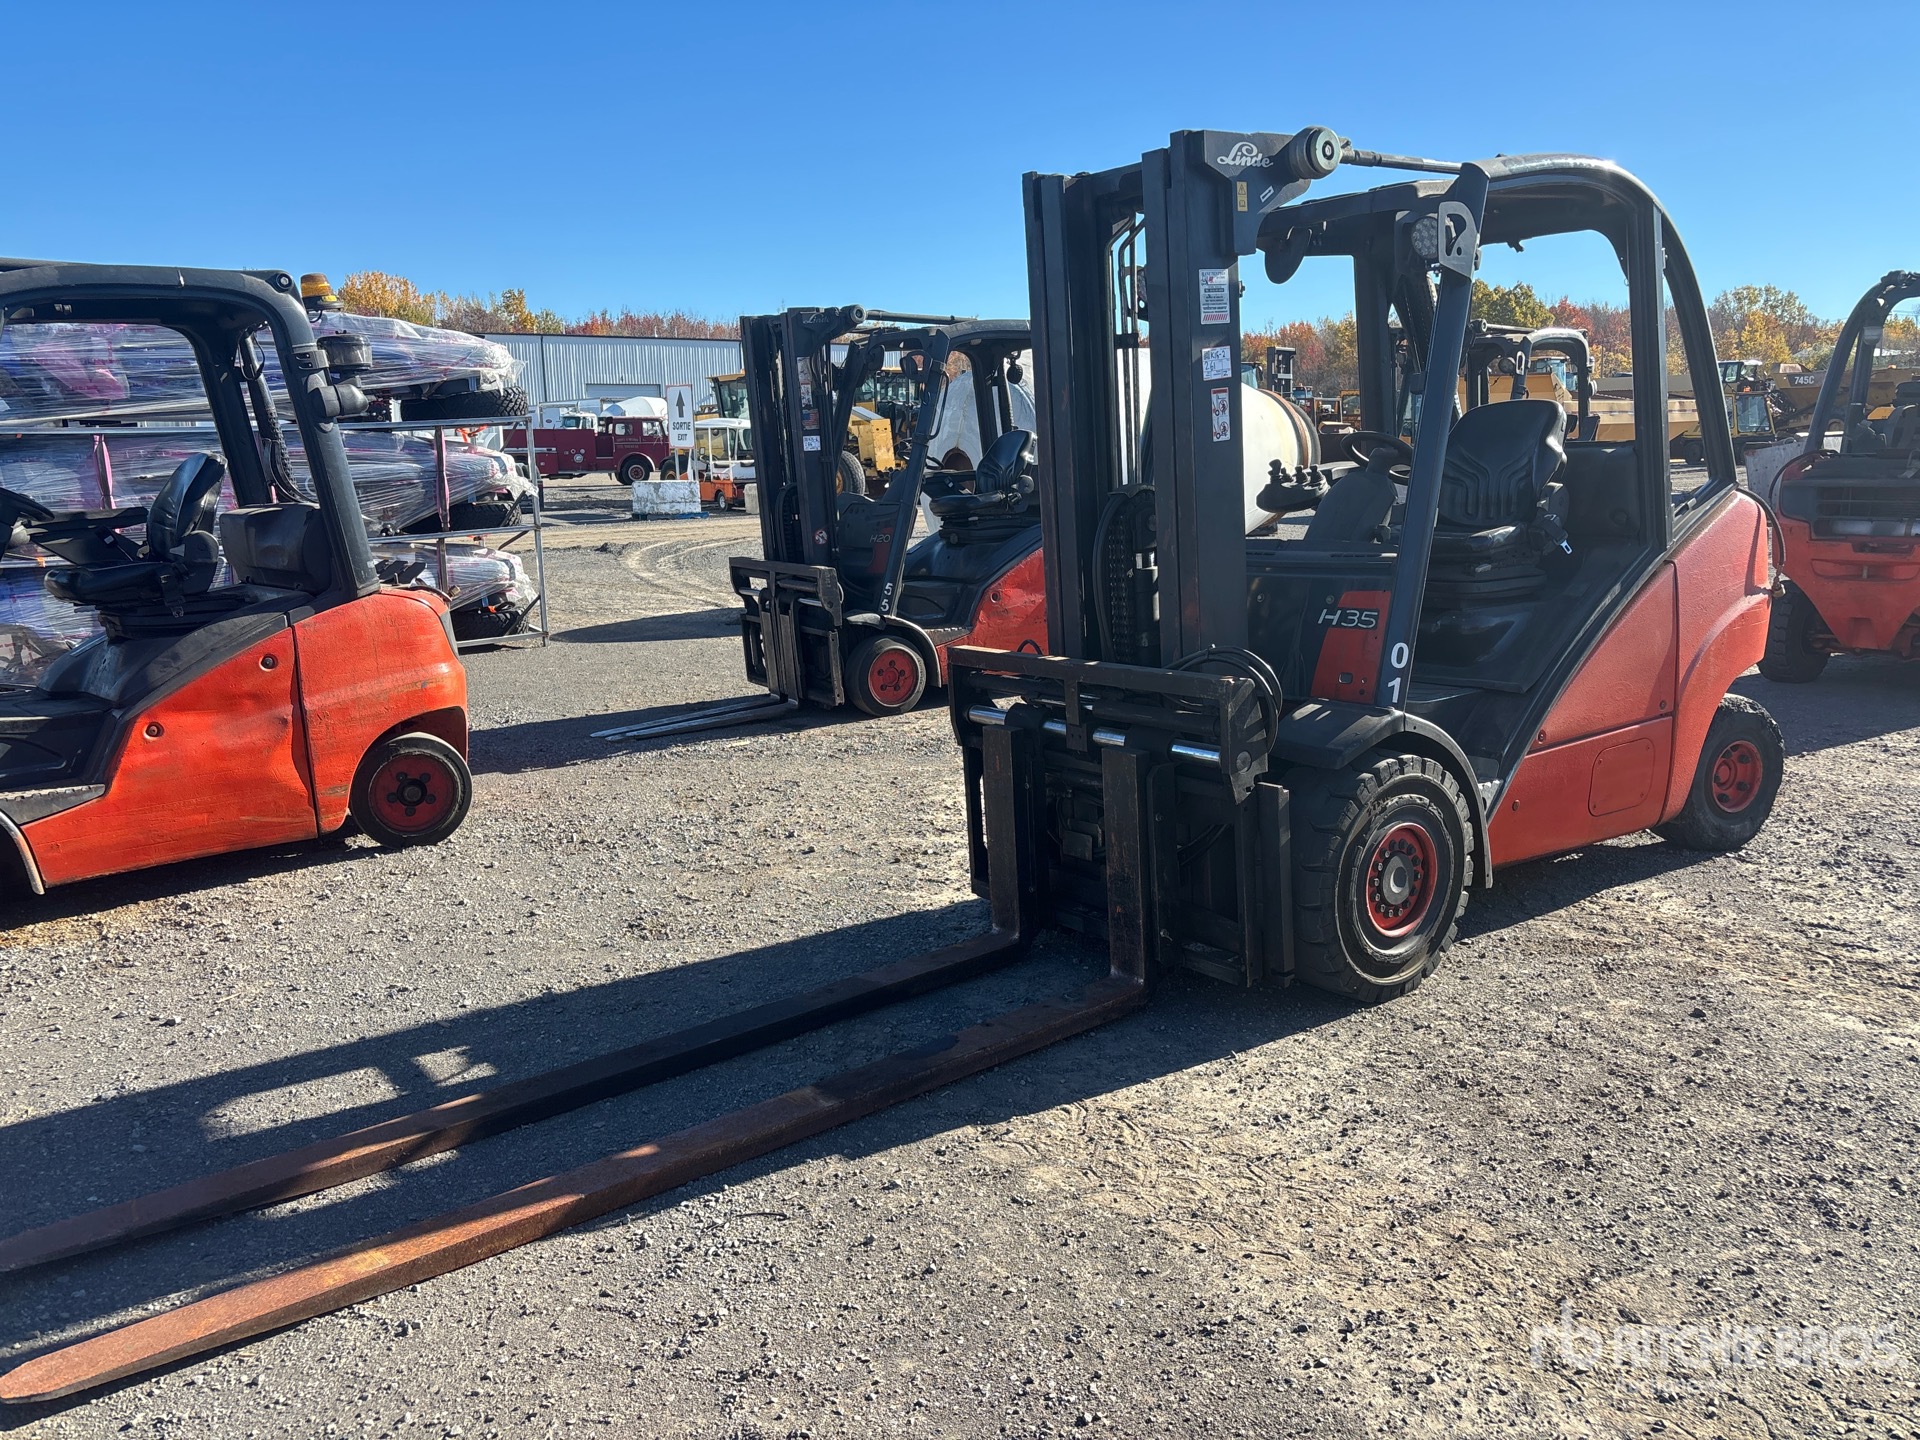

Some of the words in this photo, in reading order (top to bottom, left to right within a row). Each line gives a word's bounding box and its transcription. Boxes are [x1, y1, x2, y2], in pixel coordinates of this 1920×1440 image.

[1216, 141, 1274, 168] Linde
[1794, 375, 1815, 385] 745C
[672, 421, 691, 431] SORTIE
[677, 433, 688, 441] EXIT
[869, 534, 891, 543] H20
[1317, 608, 1379, 629] H35
